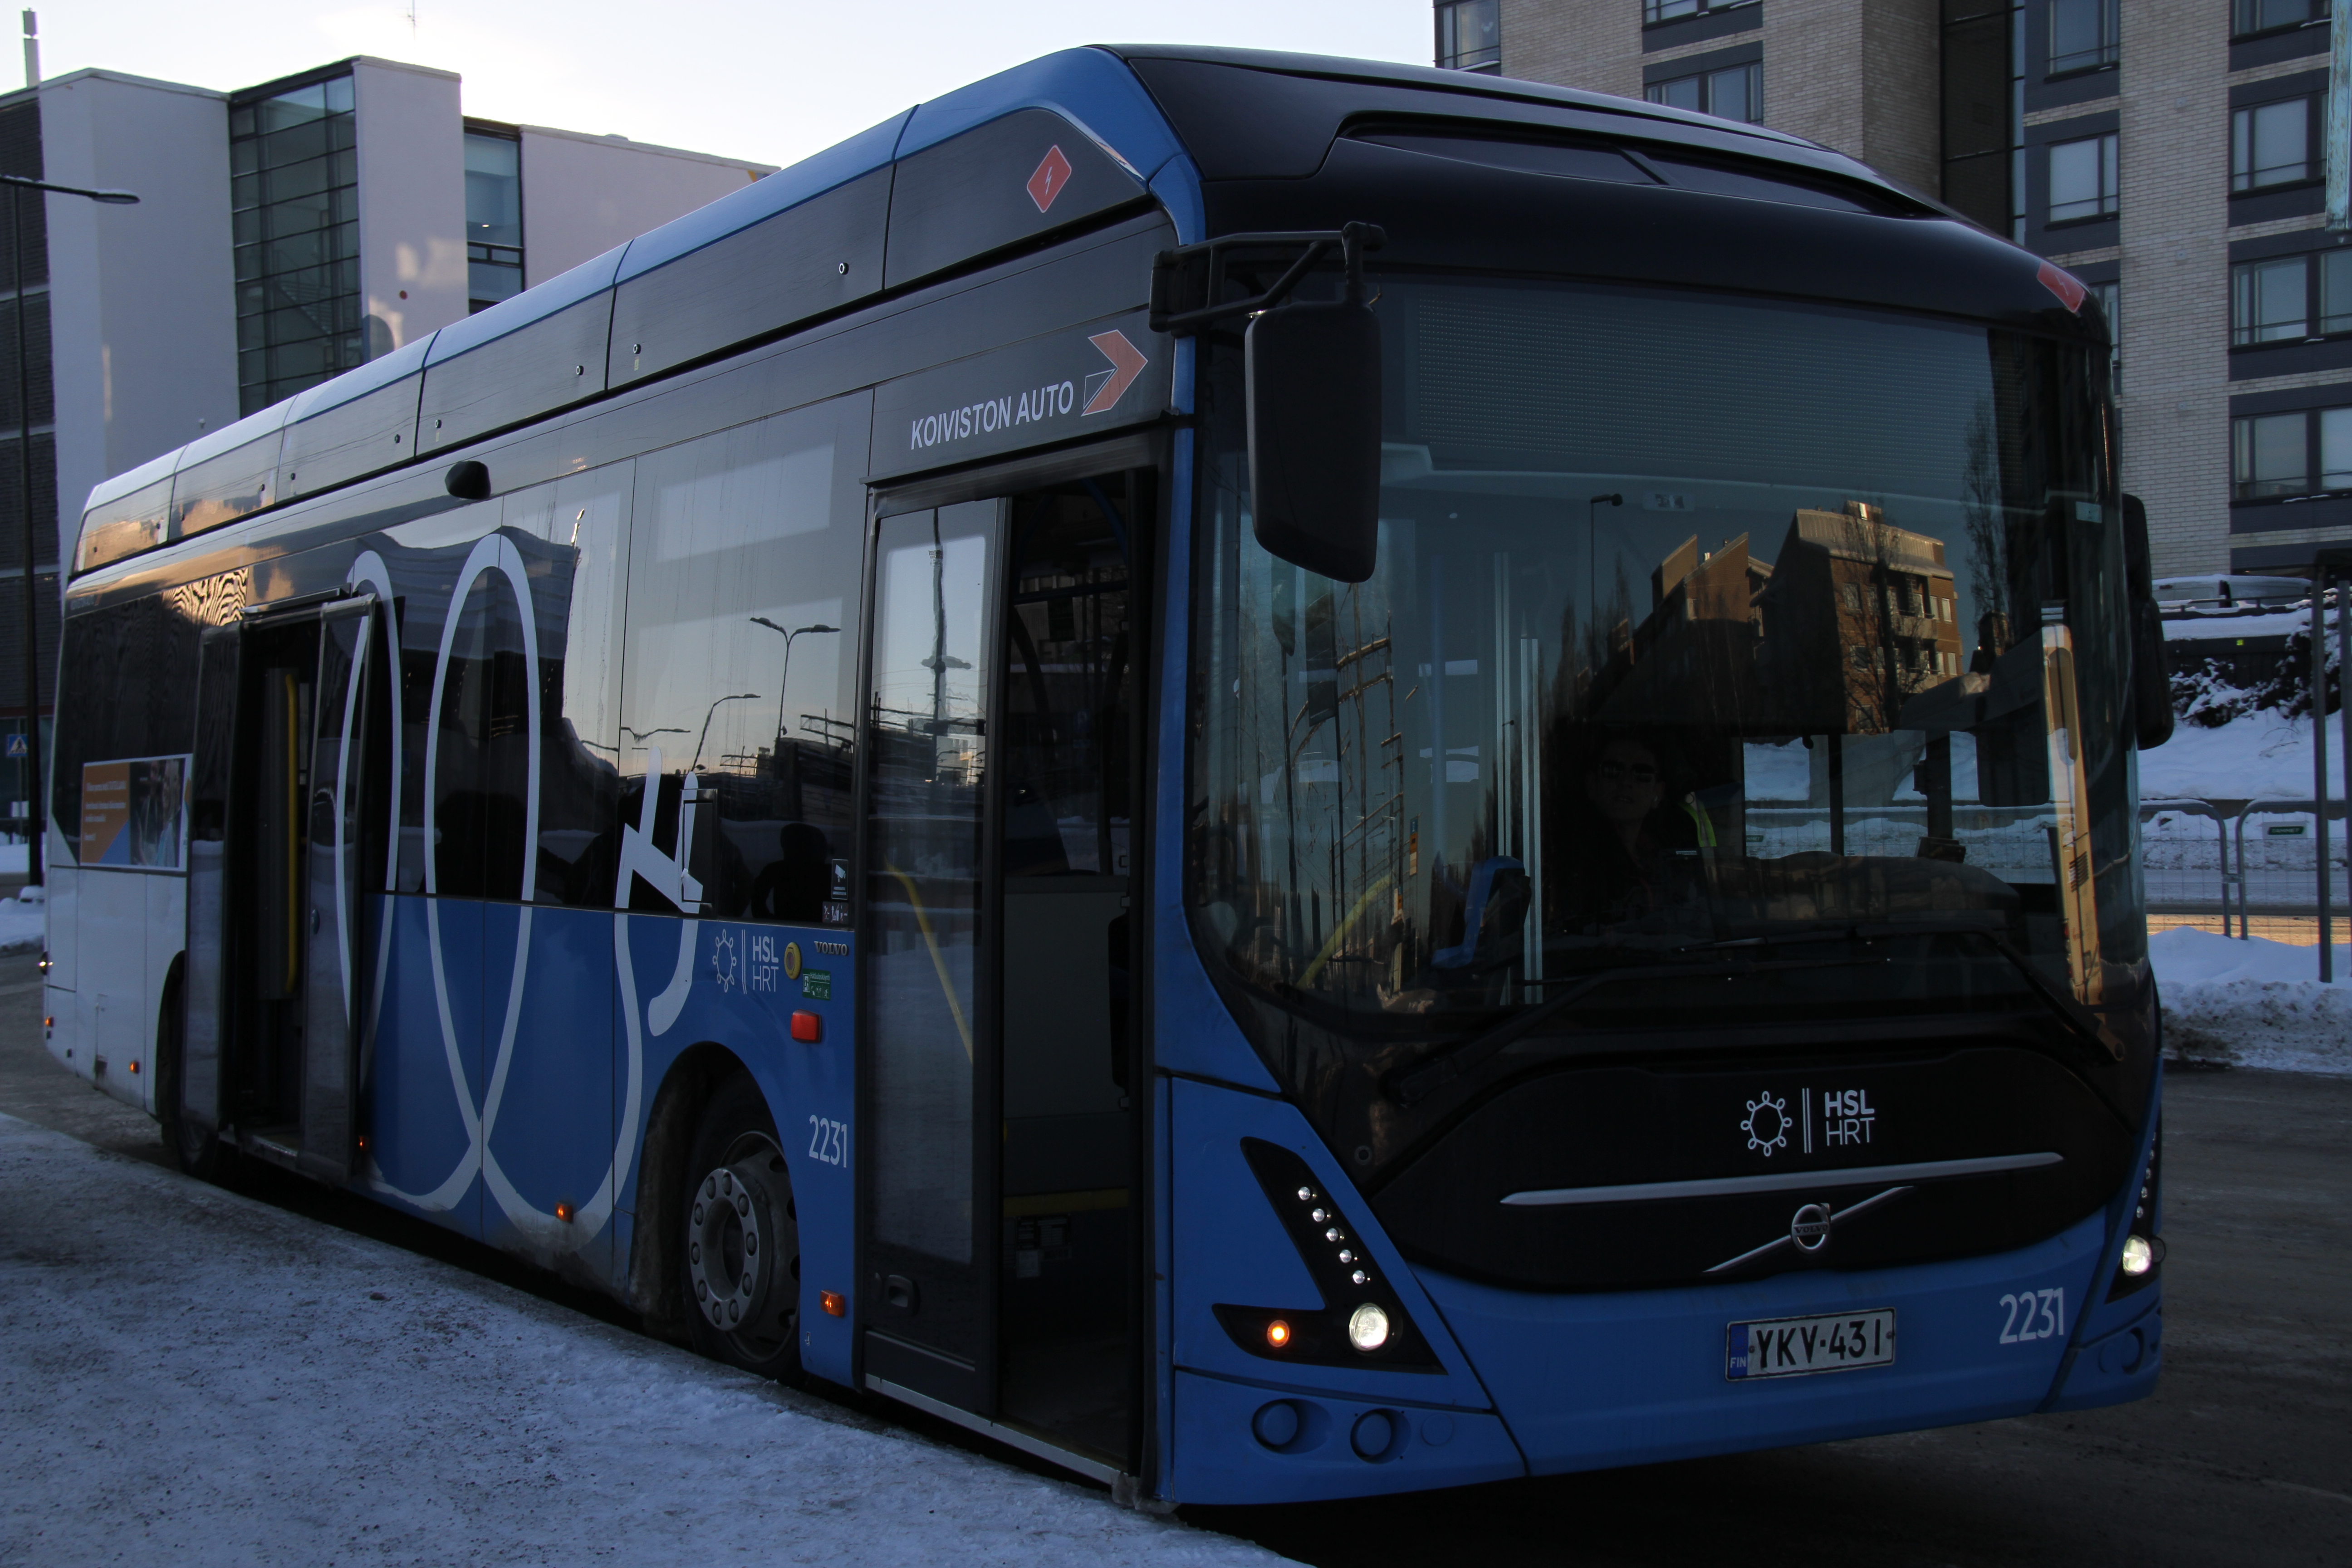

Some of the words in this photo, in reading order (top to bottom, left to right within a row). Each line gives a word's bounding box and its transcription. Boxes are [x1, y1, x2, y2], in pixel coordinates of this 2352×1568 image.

[911, 396, 1012, 450] KOIVISTON
[1015, 381, 1074, 426] AUTO
[753, 936, 779, 963] HSL
[813, 941, 849, 956] VOLVO
[753, 965, 779, 992] HRT
[1824, 1089, 1875, 1117] HSL
[809, 1114, 847, 1168] 2231
[1826, 1117, 1875, 1147] HRT
[1793, 1225, 1828, 1234] VOLVO
[1999, 1287, 2066, 1344] 2231
[1756, 1318, 1881, 1369] YKV-431
[1730, 1356, 1747, 1368] FIN
